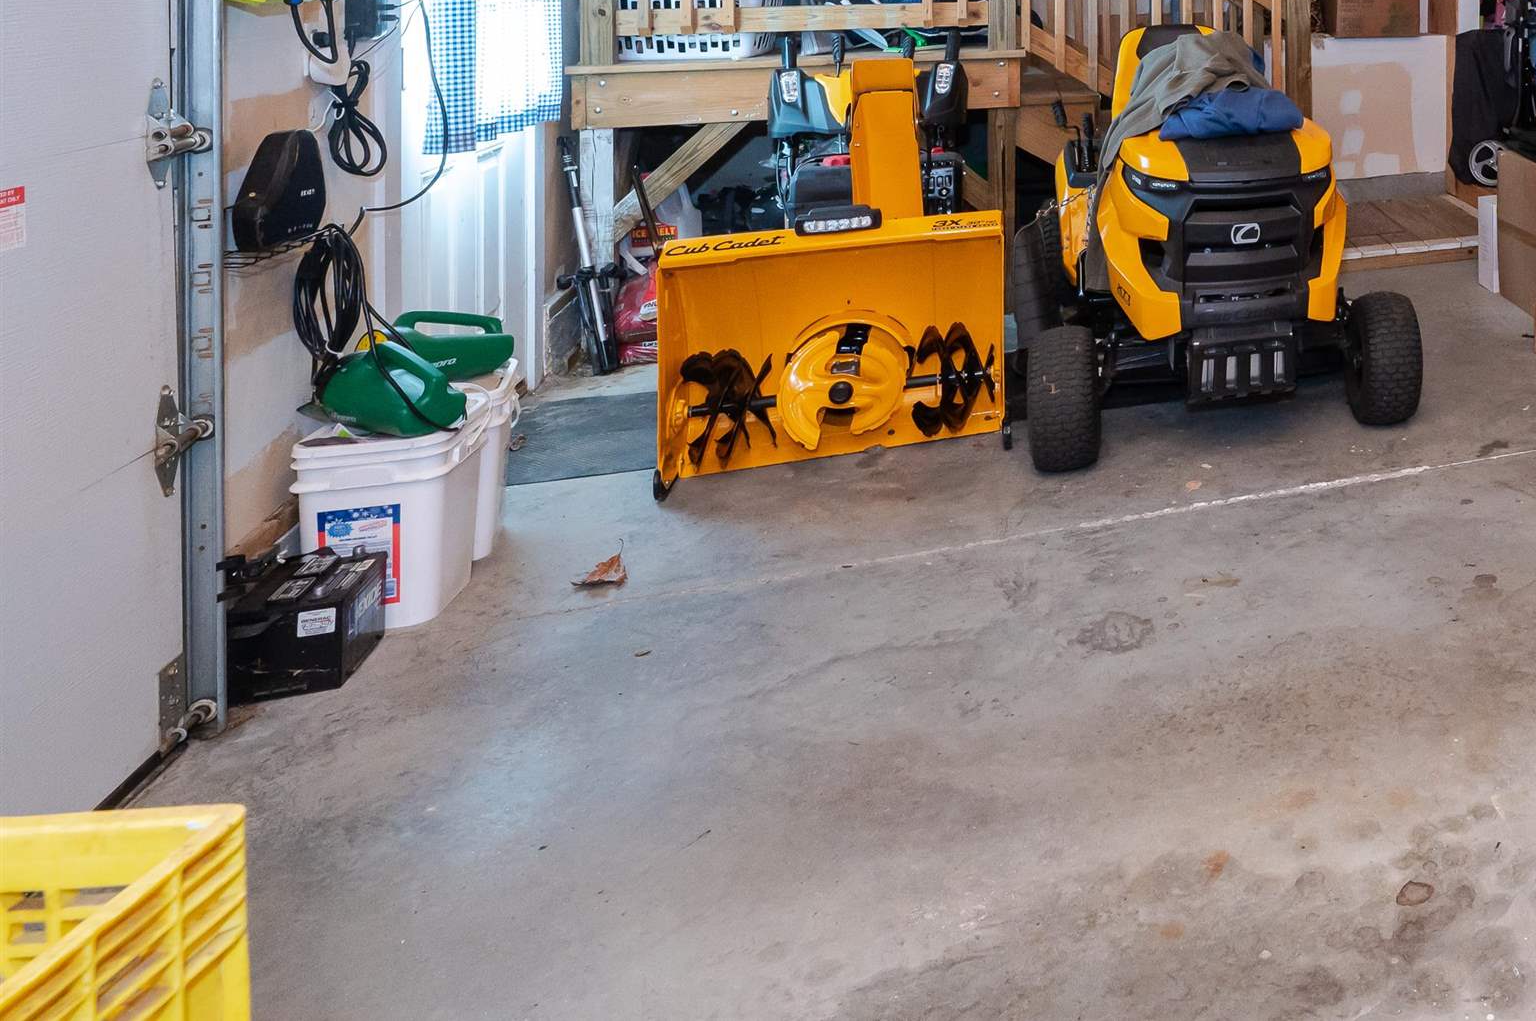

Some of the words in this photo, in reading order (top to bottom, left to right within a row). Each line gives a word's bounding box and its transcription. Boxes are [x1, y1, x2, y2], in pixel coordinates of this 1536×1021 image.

[657, 226, 677, 236] ELT
[665, 243, 709, 256] Cub
[713, 236, 785, 251] Cadet
